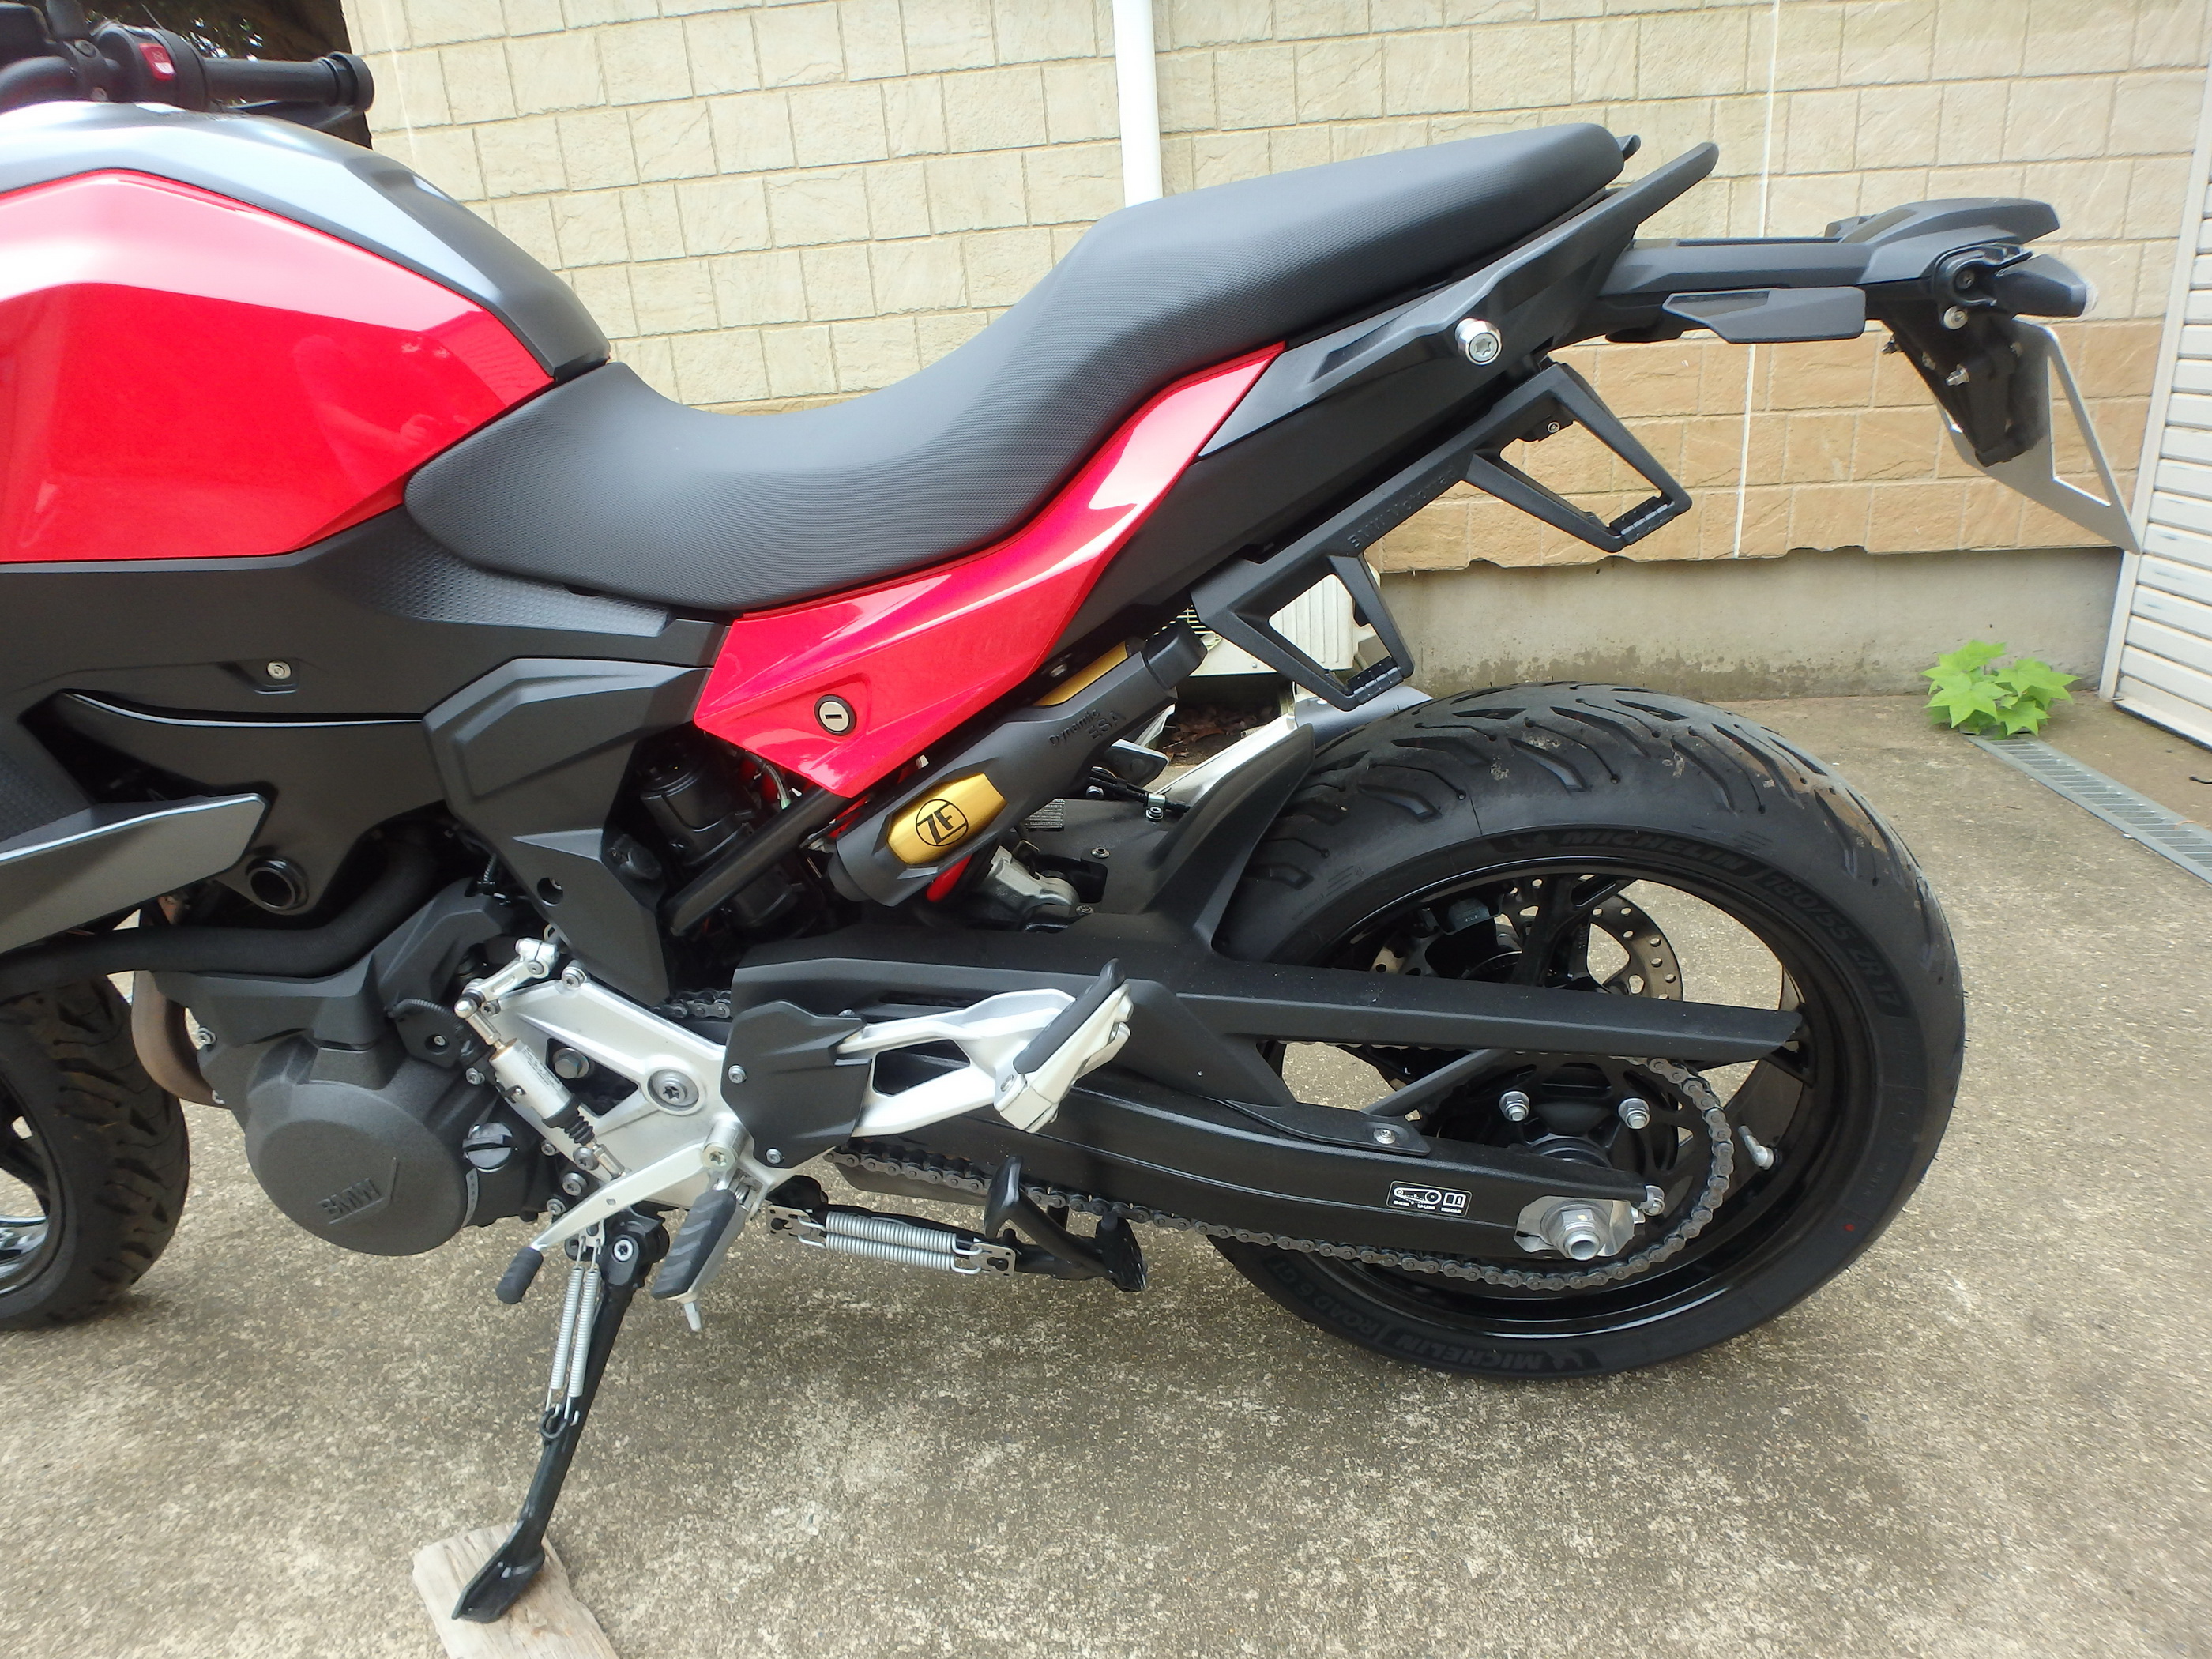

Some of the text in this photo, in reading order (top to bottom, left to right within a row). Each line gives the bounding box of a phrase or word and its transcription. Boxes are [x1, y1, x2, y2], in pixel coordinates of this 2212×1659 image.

[1048, 708, 1100, 747] Dynamic
[1086, 709, 1127, 740] ESA
[916, 799, 969, 845] ZF
[1559, 830, 1903, 1008] MICHELIN 180/55 ZR 17
[316, 1177, 382, 1217] BMW
[1272, 1260, 1545, 1371] MICHELIN ROAD 6 GT
